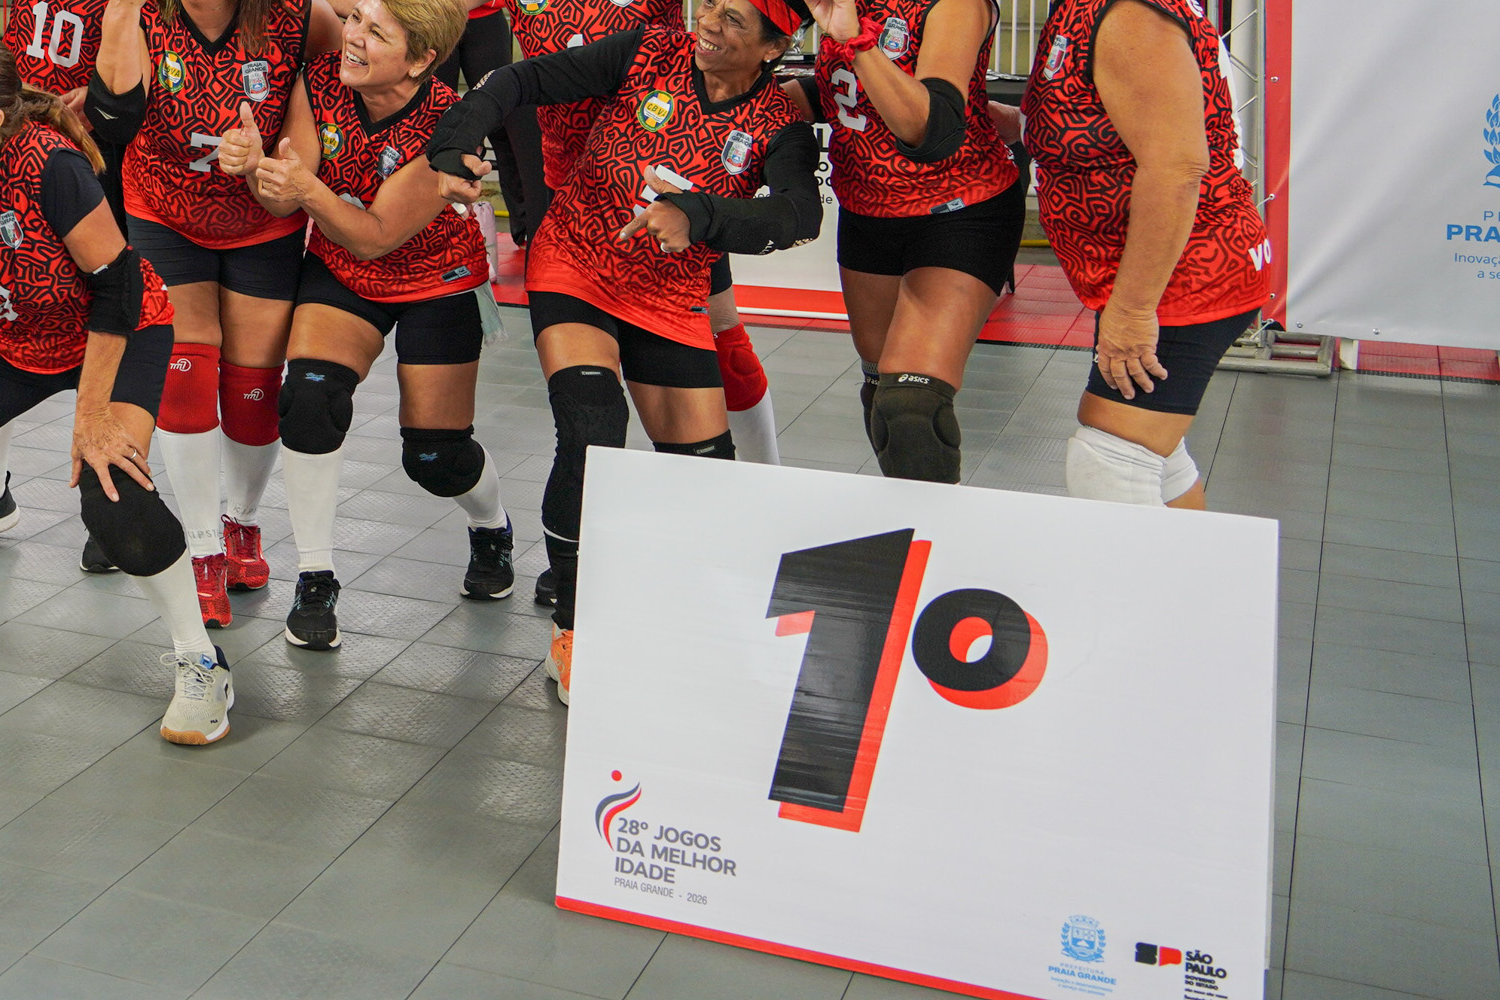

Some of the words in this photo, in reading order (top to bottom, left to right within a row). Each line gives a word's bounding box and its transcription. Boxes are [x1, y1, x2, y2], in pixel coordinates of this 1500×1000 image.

[26, 1, 84, 68] 10
[831, 68, 867, 132] 2
[189, 132, 222, 172] 7
[1476, 270, 1485, 279] a
[908, 375, 930, 384] asics
[765, 528, 1048, 833] 1º
[617, 817, 649, 836] 28º
[653, 825, 722, 852] JOGOS
[616, 836, 645, 857] DA
[651, 843, 737, 877] MELHOR
[614, 856, 676, 884] IDADE
[614, 876, 639, 891] PRAIA
[640, 882, 674, 899] GRANDE
[686, 892, 708, 905] 2026
[1060, 962, 1105, 975] PREFEITURA
[1185, 949, 1213, 965] SÃO
[1047, 965, 1076, 977] PRAIA
[1077, 971, 1117, 986] GRANDE
[1184, 974, 1216, 984] GOVERNO
[1185, 961, 1227, 979] PAULO
[1195, 982, 1219, 991] ESTADO
